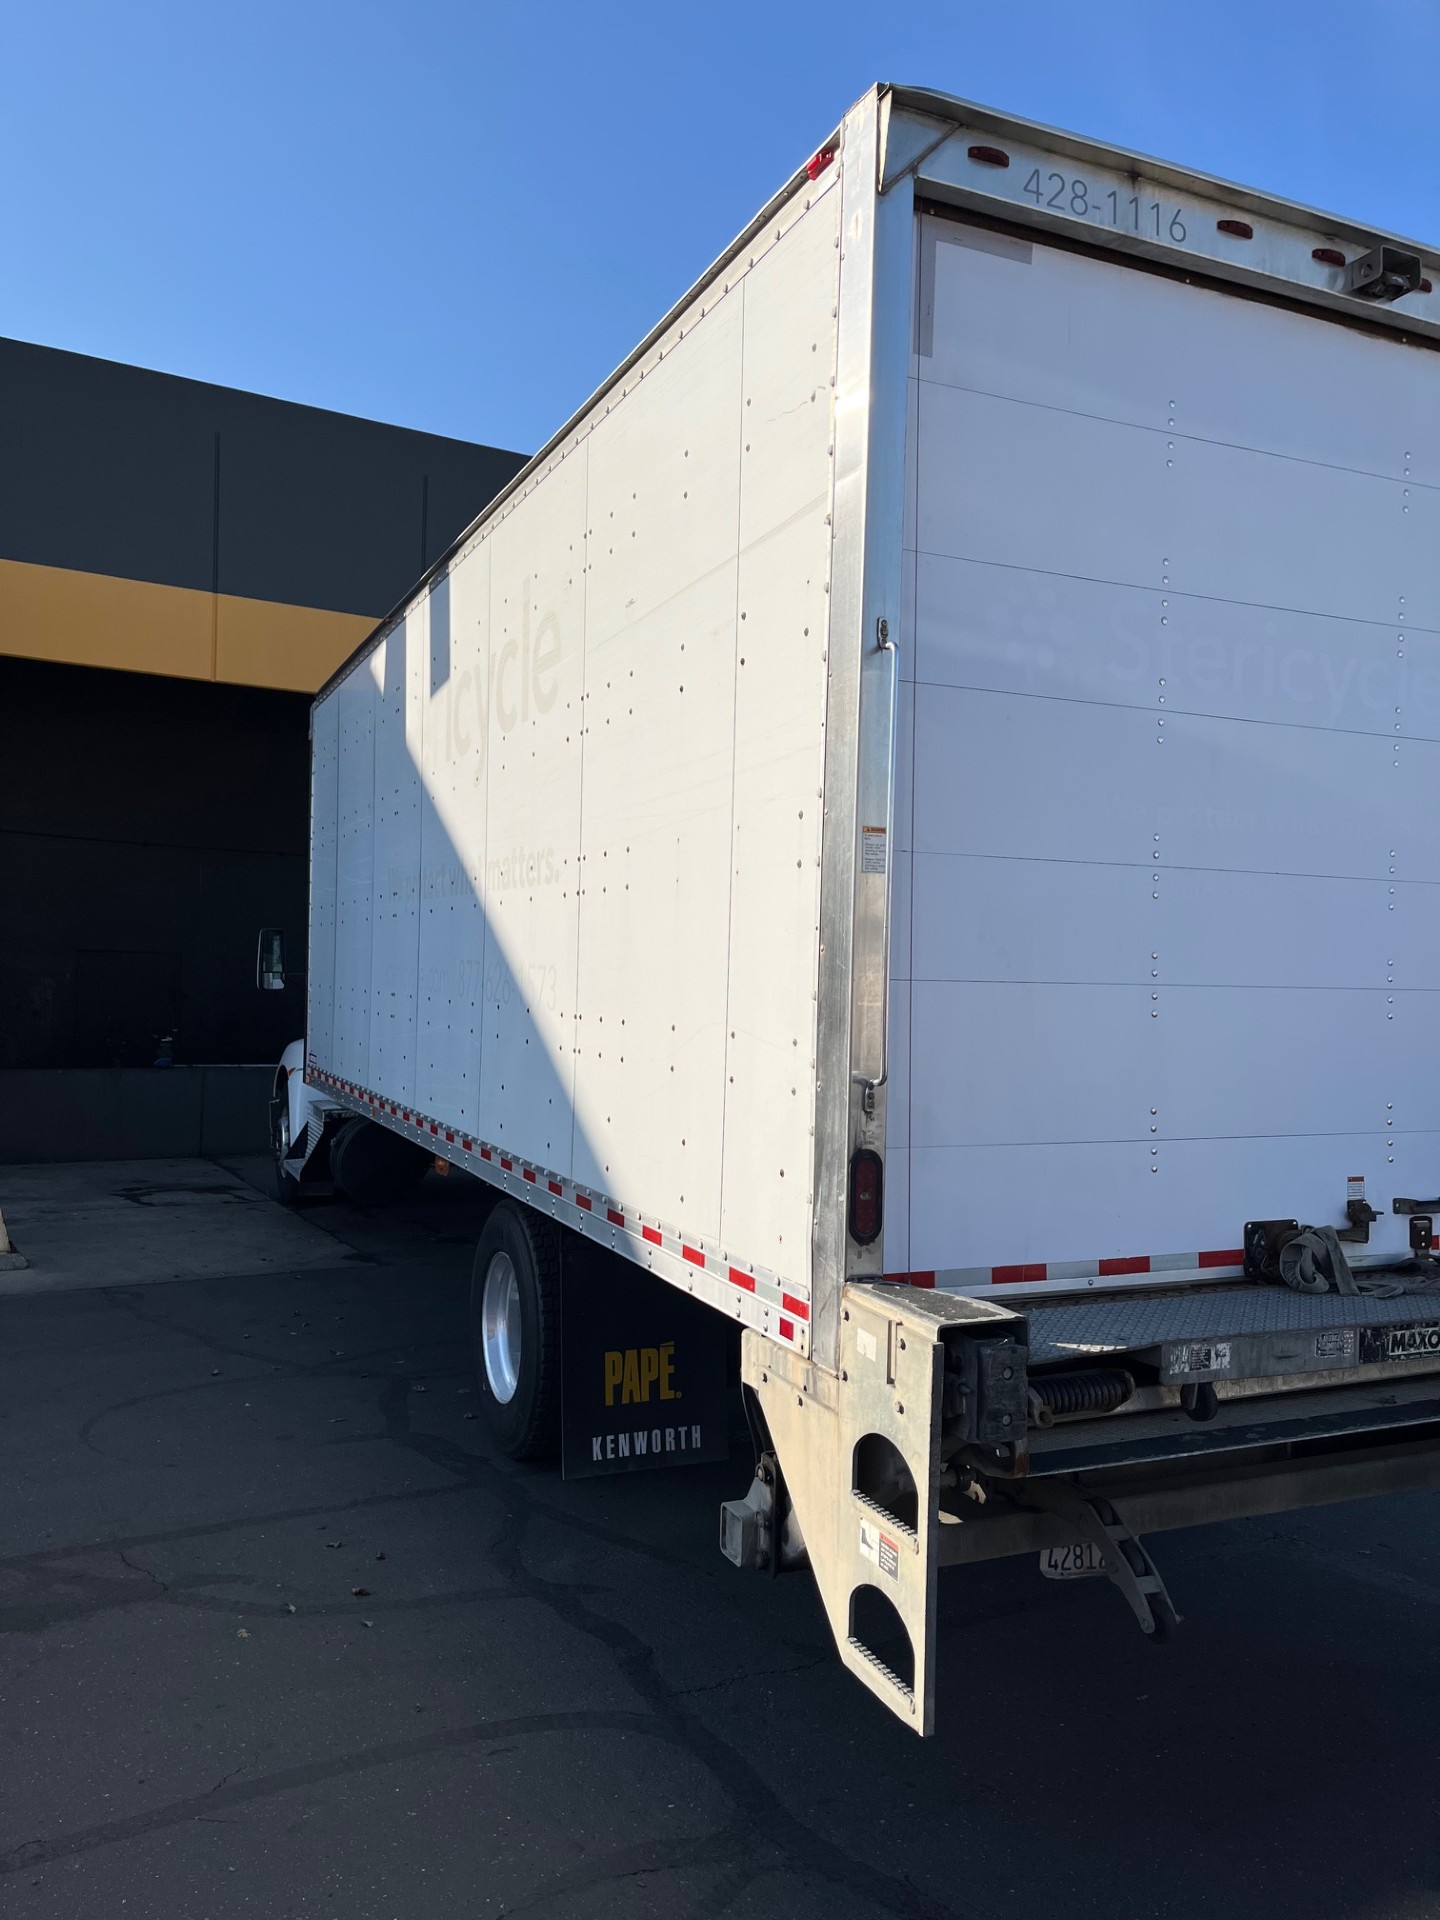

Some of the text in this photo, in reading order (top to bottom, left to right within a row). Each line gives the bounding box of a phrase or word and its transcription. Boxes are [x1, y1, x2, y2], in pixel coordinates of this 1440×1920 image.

[1023, 168, 1188, 243] 428-1116
[487, 846, 560, 892] matters.
[592, 1424, 702, 1462] KENWORTH
